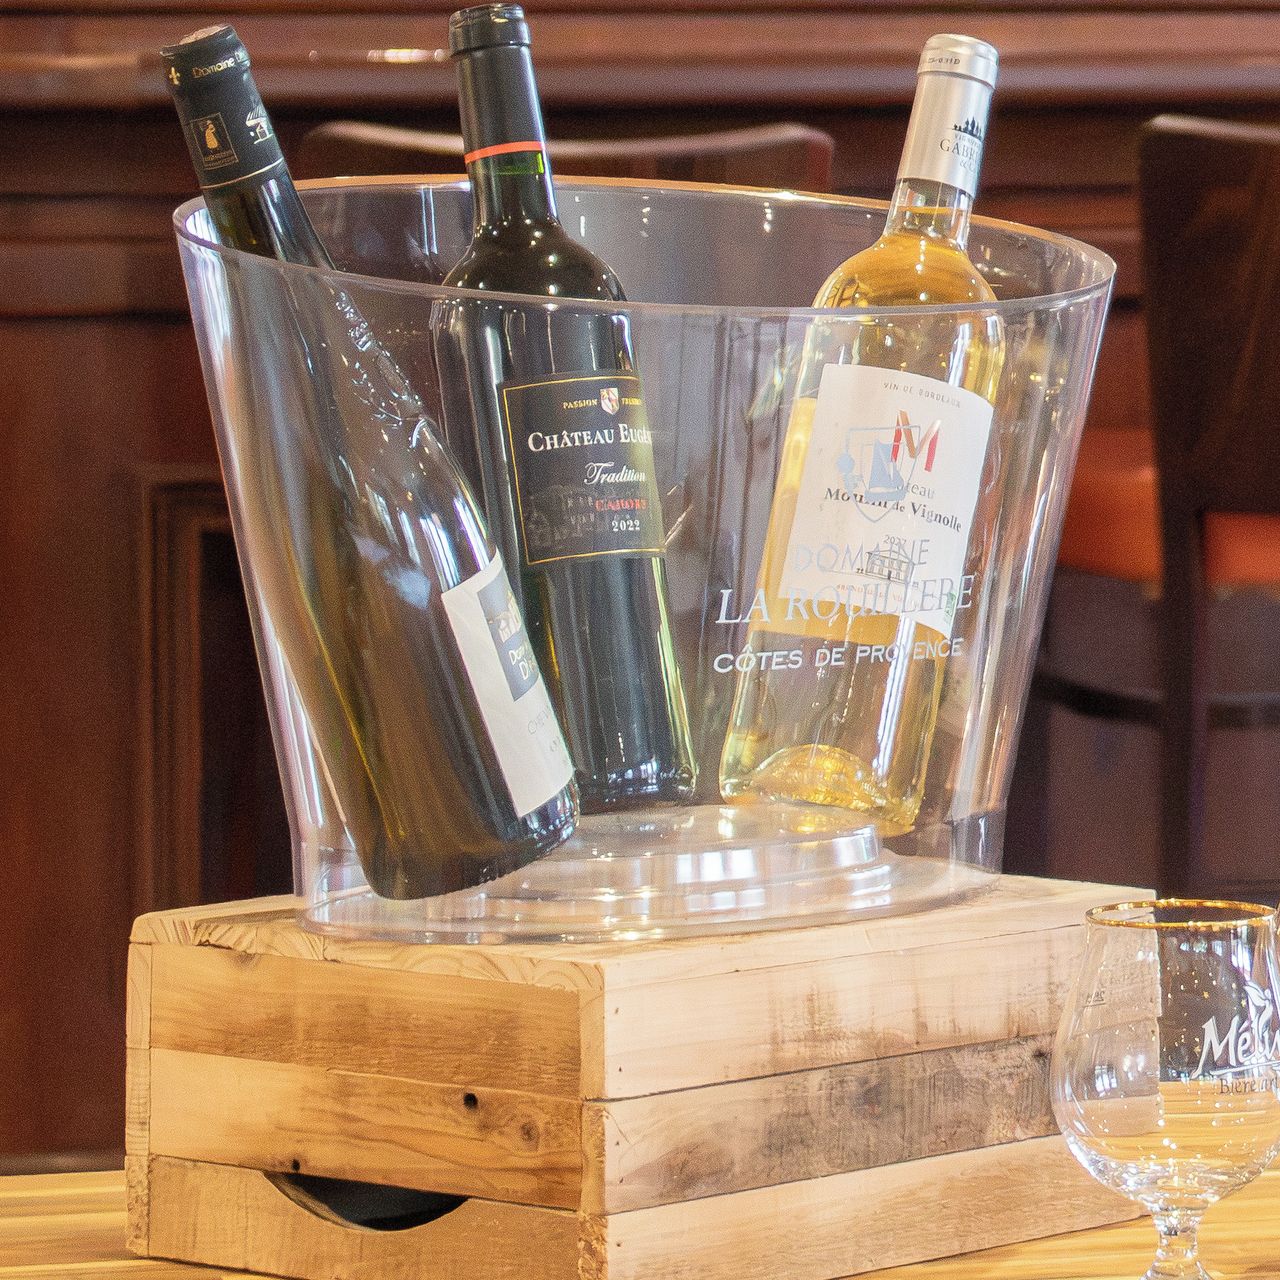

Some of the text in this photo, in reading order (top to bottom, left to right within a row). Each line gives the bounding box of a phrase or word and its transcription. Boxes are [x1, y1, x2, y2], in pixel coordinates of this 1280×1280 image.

[583, 462, 647, 486] Tradition
[611, 519, 642, 532] 2022
[910, 501, 963, 534] Vignolle
[796, 539, 931, 574] DOMAINE
[715, 587, 771, 625] LA
[713, 636, 964, 673] CÔTES DE PROVENCE
